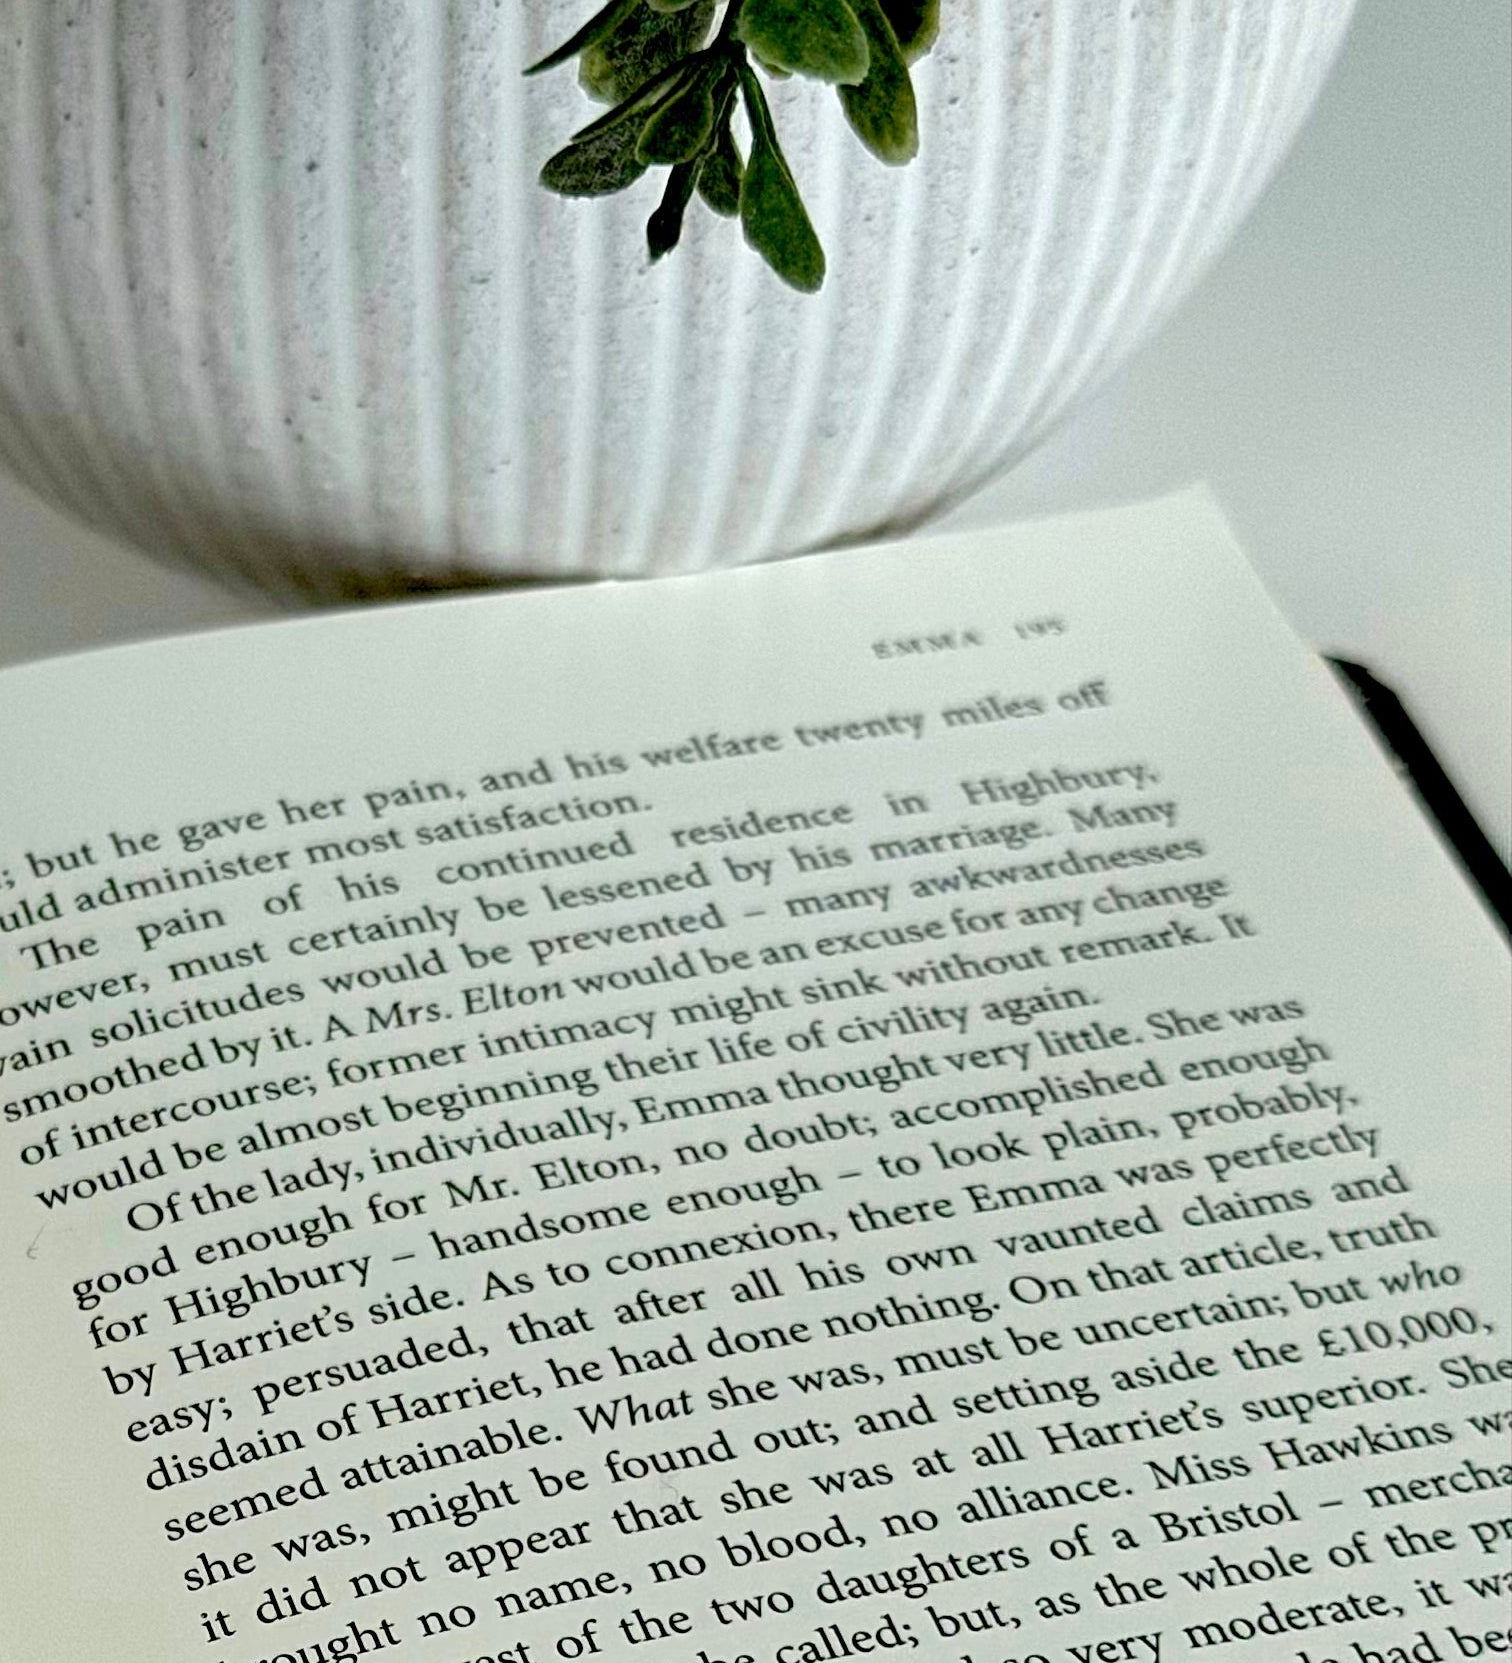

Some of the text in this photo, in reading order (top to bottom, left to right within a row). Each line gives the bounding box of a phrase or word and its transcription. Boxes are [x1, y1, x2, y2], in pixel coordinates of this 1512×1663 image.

[871, 630, 983, 660] EMMA
[17, 763, 1158, 972] The pain of his continued residence in Highbury,
[22, 841, 99, 881] but
[106, 829, 163, 861] he
[175, 810, 269, 855] gave
[275, 796, 347, 827] her
[361, 777, 469, 821] pain,
[477, 755, 555, 795] and
[562, 751, 631, 781] his
[638, 731, 782, 769] welfare
[792, 712, 925, 749] twenty
[939, 694, 1046, 729] miles
[1056, 678, 1108, 711] off
[19, 912, 1256, 1167] of intercourse; former intimacy might sink without remark. It
[72, 1035, 1331, 1312] good enough for Mr. Elton, no doubt; accomplished enough
[127, 1163, 1412, 1443] easy; persuaded, that after all his own vaunted claims and
[183, 1306, 1495, 1592] she was, might be found out; and setting aside the £10,000,
[1181, 1593, 1406, 1649] moderate,
[1413, 1578, 1455, 1609] it
